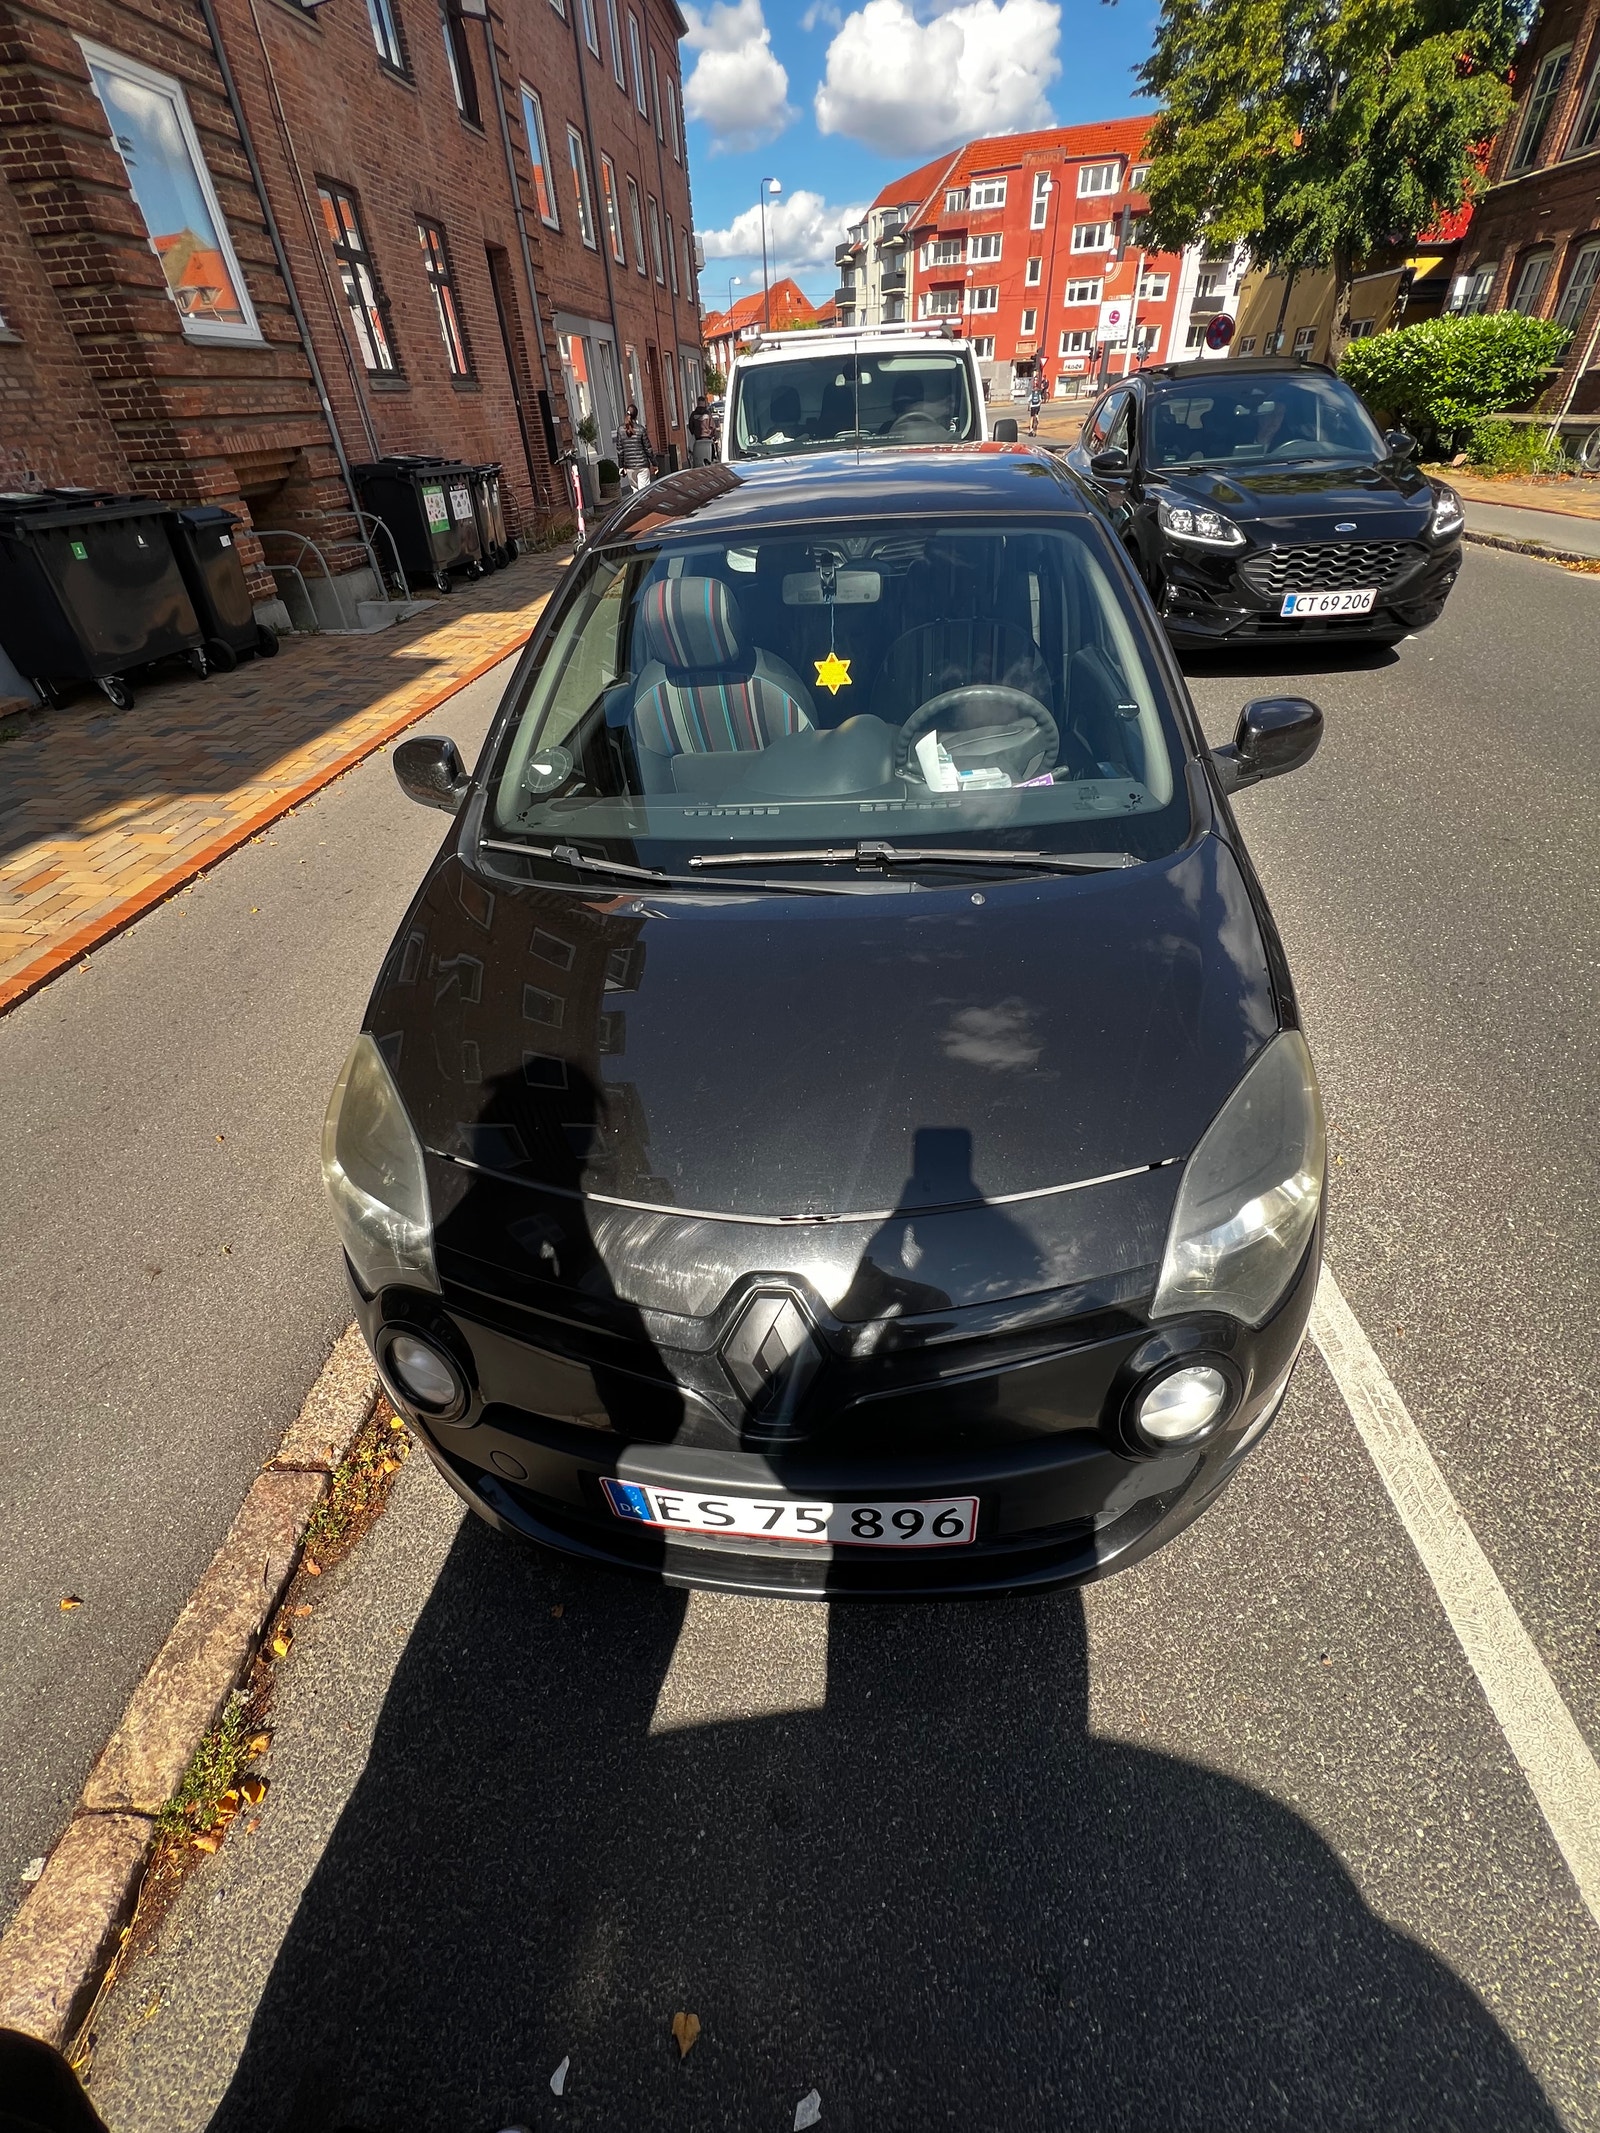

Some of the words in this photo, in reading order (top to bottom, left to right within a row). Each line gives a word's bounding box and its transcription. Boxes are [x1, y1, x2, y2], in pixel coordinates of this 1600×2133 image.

[1296, 597, 1319, 612] CT
[1319, 595, 1341, 611] 69
[1341, 593, 1371, 610] 206
[620, 1503, 643, 1515] DK
[654, 1494, 736, 1527] ES
[752, 1505, 827, 1534] 75
[849, 1507, 965, 1540] 896
